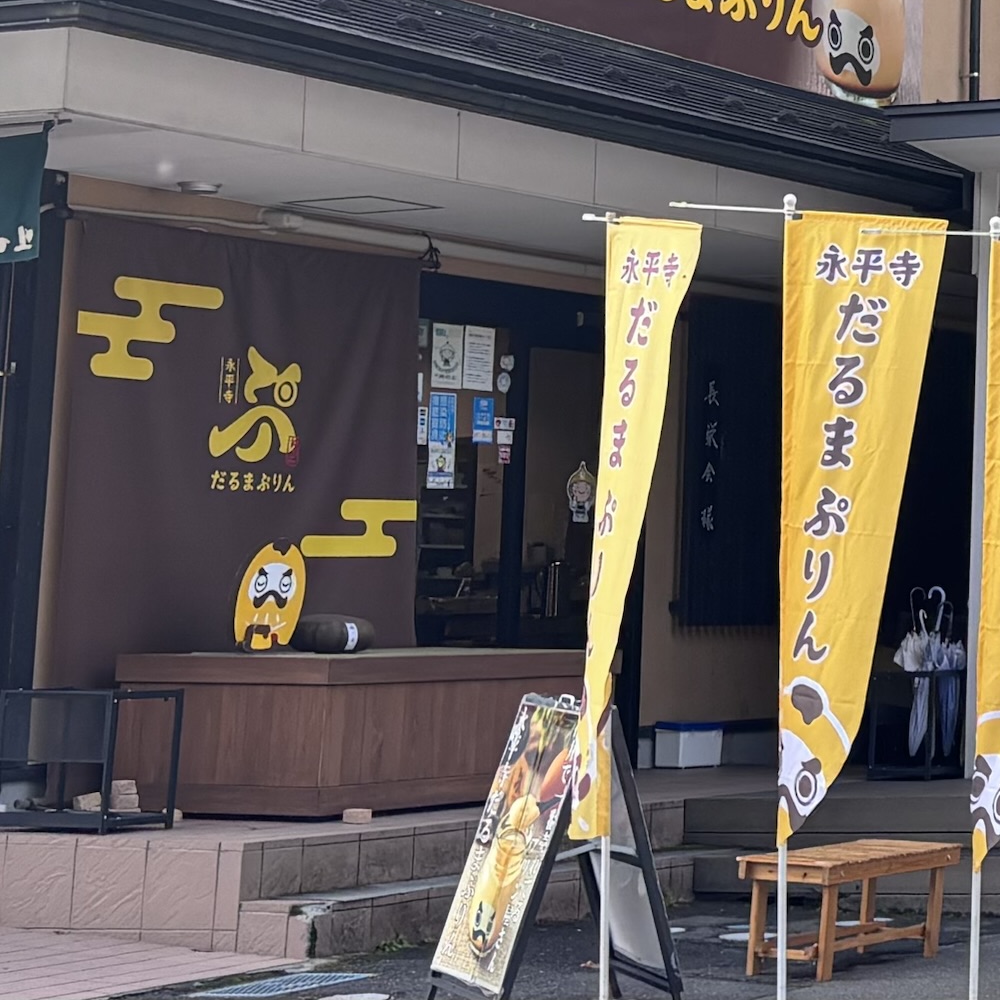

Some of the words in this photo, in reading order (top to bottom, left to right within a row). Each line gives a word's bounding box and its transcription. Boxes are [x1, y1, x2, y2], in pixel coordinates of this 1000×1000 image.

[620, 248, 679, 288] 永平寺
[815, 244, 922, 289] 永平寺
[223, 357, 237, 404] 永平寺
[210, 469, 296, 493] だるまぷりん
[588, 297, 658, 657] だるまぷ
[792, 293, 889, 662] だるまぷりん
